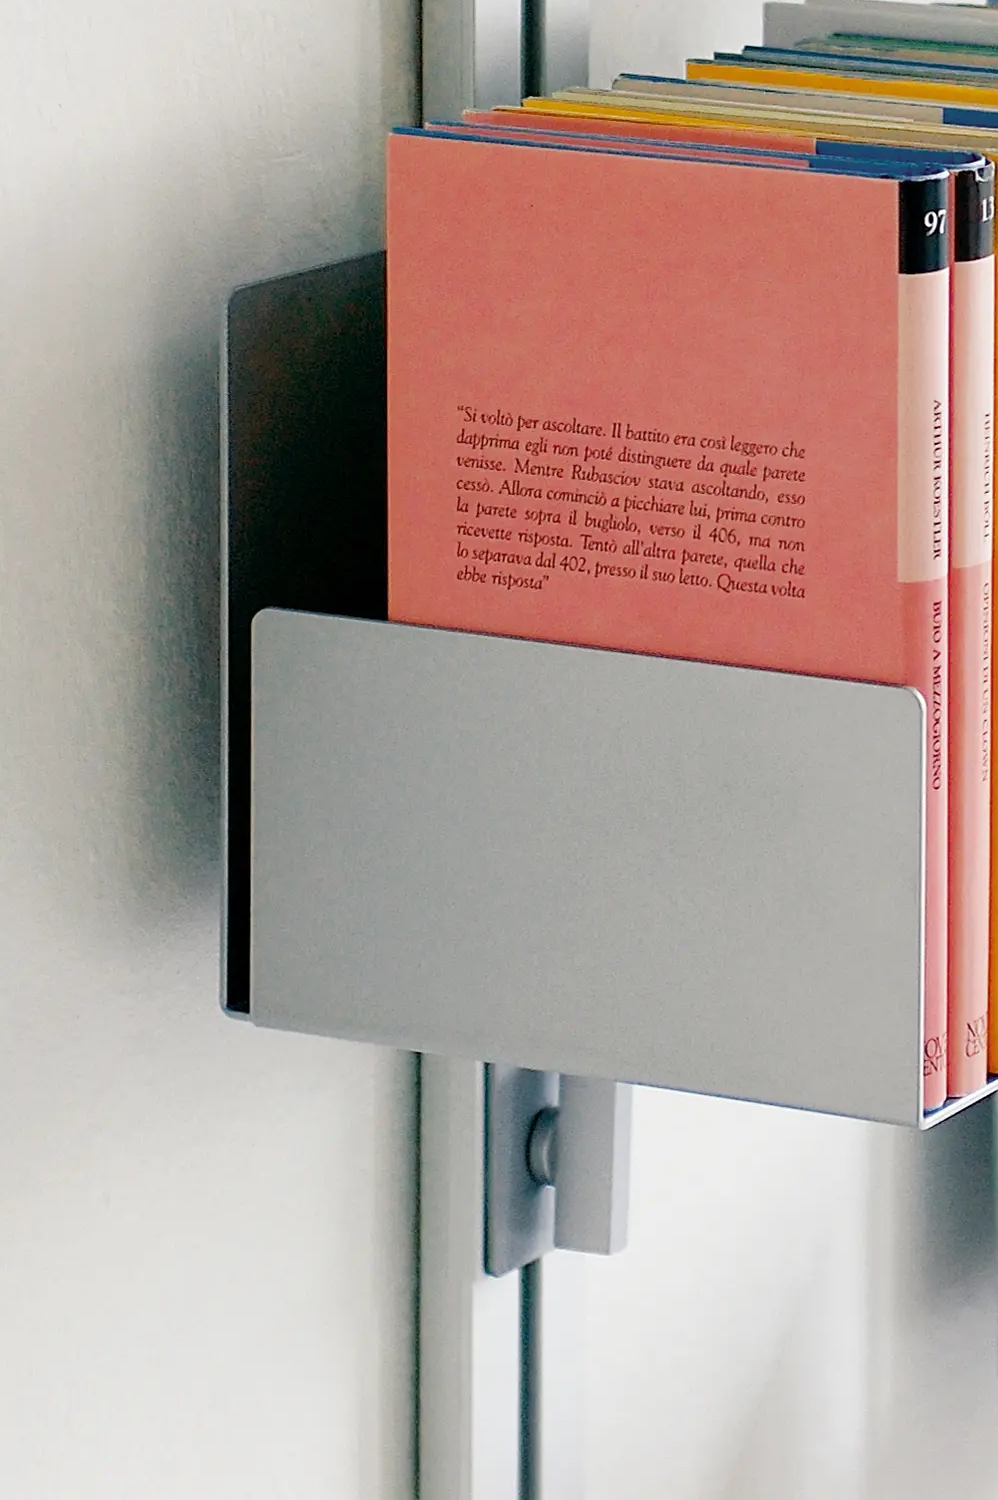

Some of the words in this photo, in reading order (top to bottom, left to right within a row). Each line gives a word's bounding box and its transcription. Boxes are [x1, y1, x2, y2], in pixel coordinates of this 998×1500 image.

[924, 209, 947, 236] 97
[457, 427, 519, 450] dapprima
[525, 436, 547, 457] egli
[553, 444, 578, 457] non
[584, 445, 612, 462] poté
[618, 446, 691, 470] distinguere
[697, 455, 714, 473] da
[720, 460, 757, 478] quale
[763, 466, 805, 483] parete
[481, 409, 513, 427] voltò
[517, 415, 539, 432] per
[542, 417, 606, 437] ascoltare.
[612, 422, 621, 439] Il
[626, 423, 669, 444] battito
[674, 435, 695, 447] era
[700, 436, 725, 450] così
[730, 435, 777, 457] leggero
[782, 441, 805, 459] che
[933, 399, 942, 470] ARTHUR
[457, 455, 506, 472] venisse.
[514, 457, 563, 478] Mentre
[572, 464, 641, 487] Rubasciov
[648, 477, 684, 492] stava
[692, 480, 768, 504] ascoltando,
[778, 493, 805, 506] esso
[457, 478, 493, 493] cessò.
[499, 479, 542, 499] Allora
[547, 488, 607, 506] cominciò
[611, 497, 619, 508] a
[624, 495, 685, 516] picchiare
[689, 499, 710, 520] lui,
[716, 506, 756, 523] prima
[761, 515, 805, 529] contro
[457, 496, 468, 513] la
[476, 502, 517, 519] parete
[525, 509, 561, 526] sopra
[569, 509, 577, 526] il
[585, 510, 641, 534] bugliolo,
[650, 525, 685, 538] verso
[693, 523, 701, 540] il
[709, 527, 740, 547] 406,
[749, 536, 770, 548] ma
[779, 539, 804, 552] non
[933, 476, 942, 560] KOESTLER
[457, 521, 512, 541] ricevette
[518, 528, 572, 548] risposta.
[580, 534, 617, 553] Tentò
[681, 548, 727, 568] parete,
[734, 554, 776, 573] quella
[782, 558, 804, 576] che
[457, 541, 468, 558] lo
[472, 548, 531, 566] separava
[535, 551, 556, 569] dal
[560, 555, 590, 575] 402,
[595, 561, 636, 579] presso
[640, 563, 648, 580] il
[652, 570, 675, 584] suo
[679, 567, 712, 588] letto.
[717, 573, 767, 594] Questa
[771, 580, 805, 599] volta
[457, 564, 486, 584] ebbe
[932, 600, 942, 643] BUIO
[932, 649, 942, 661] A
[932, 665, 942, 791] MEZZOGIORNO
